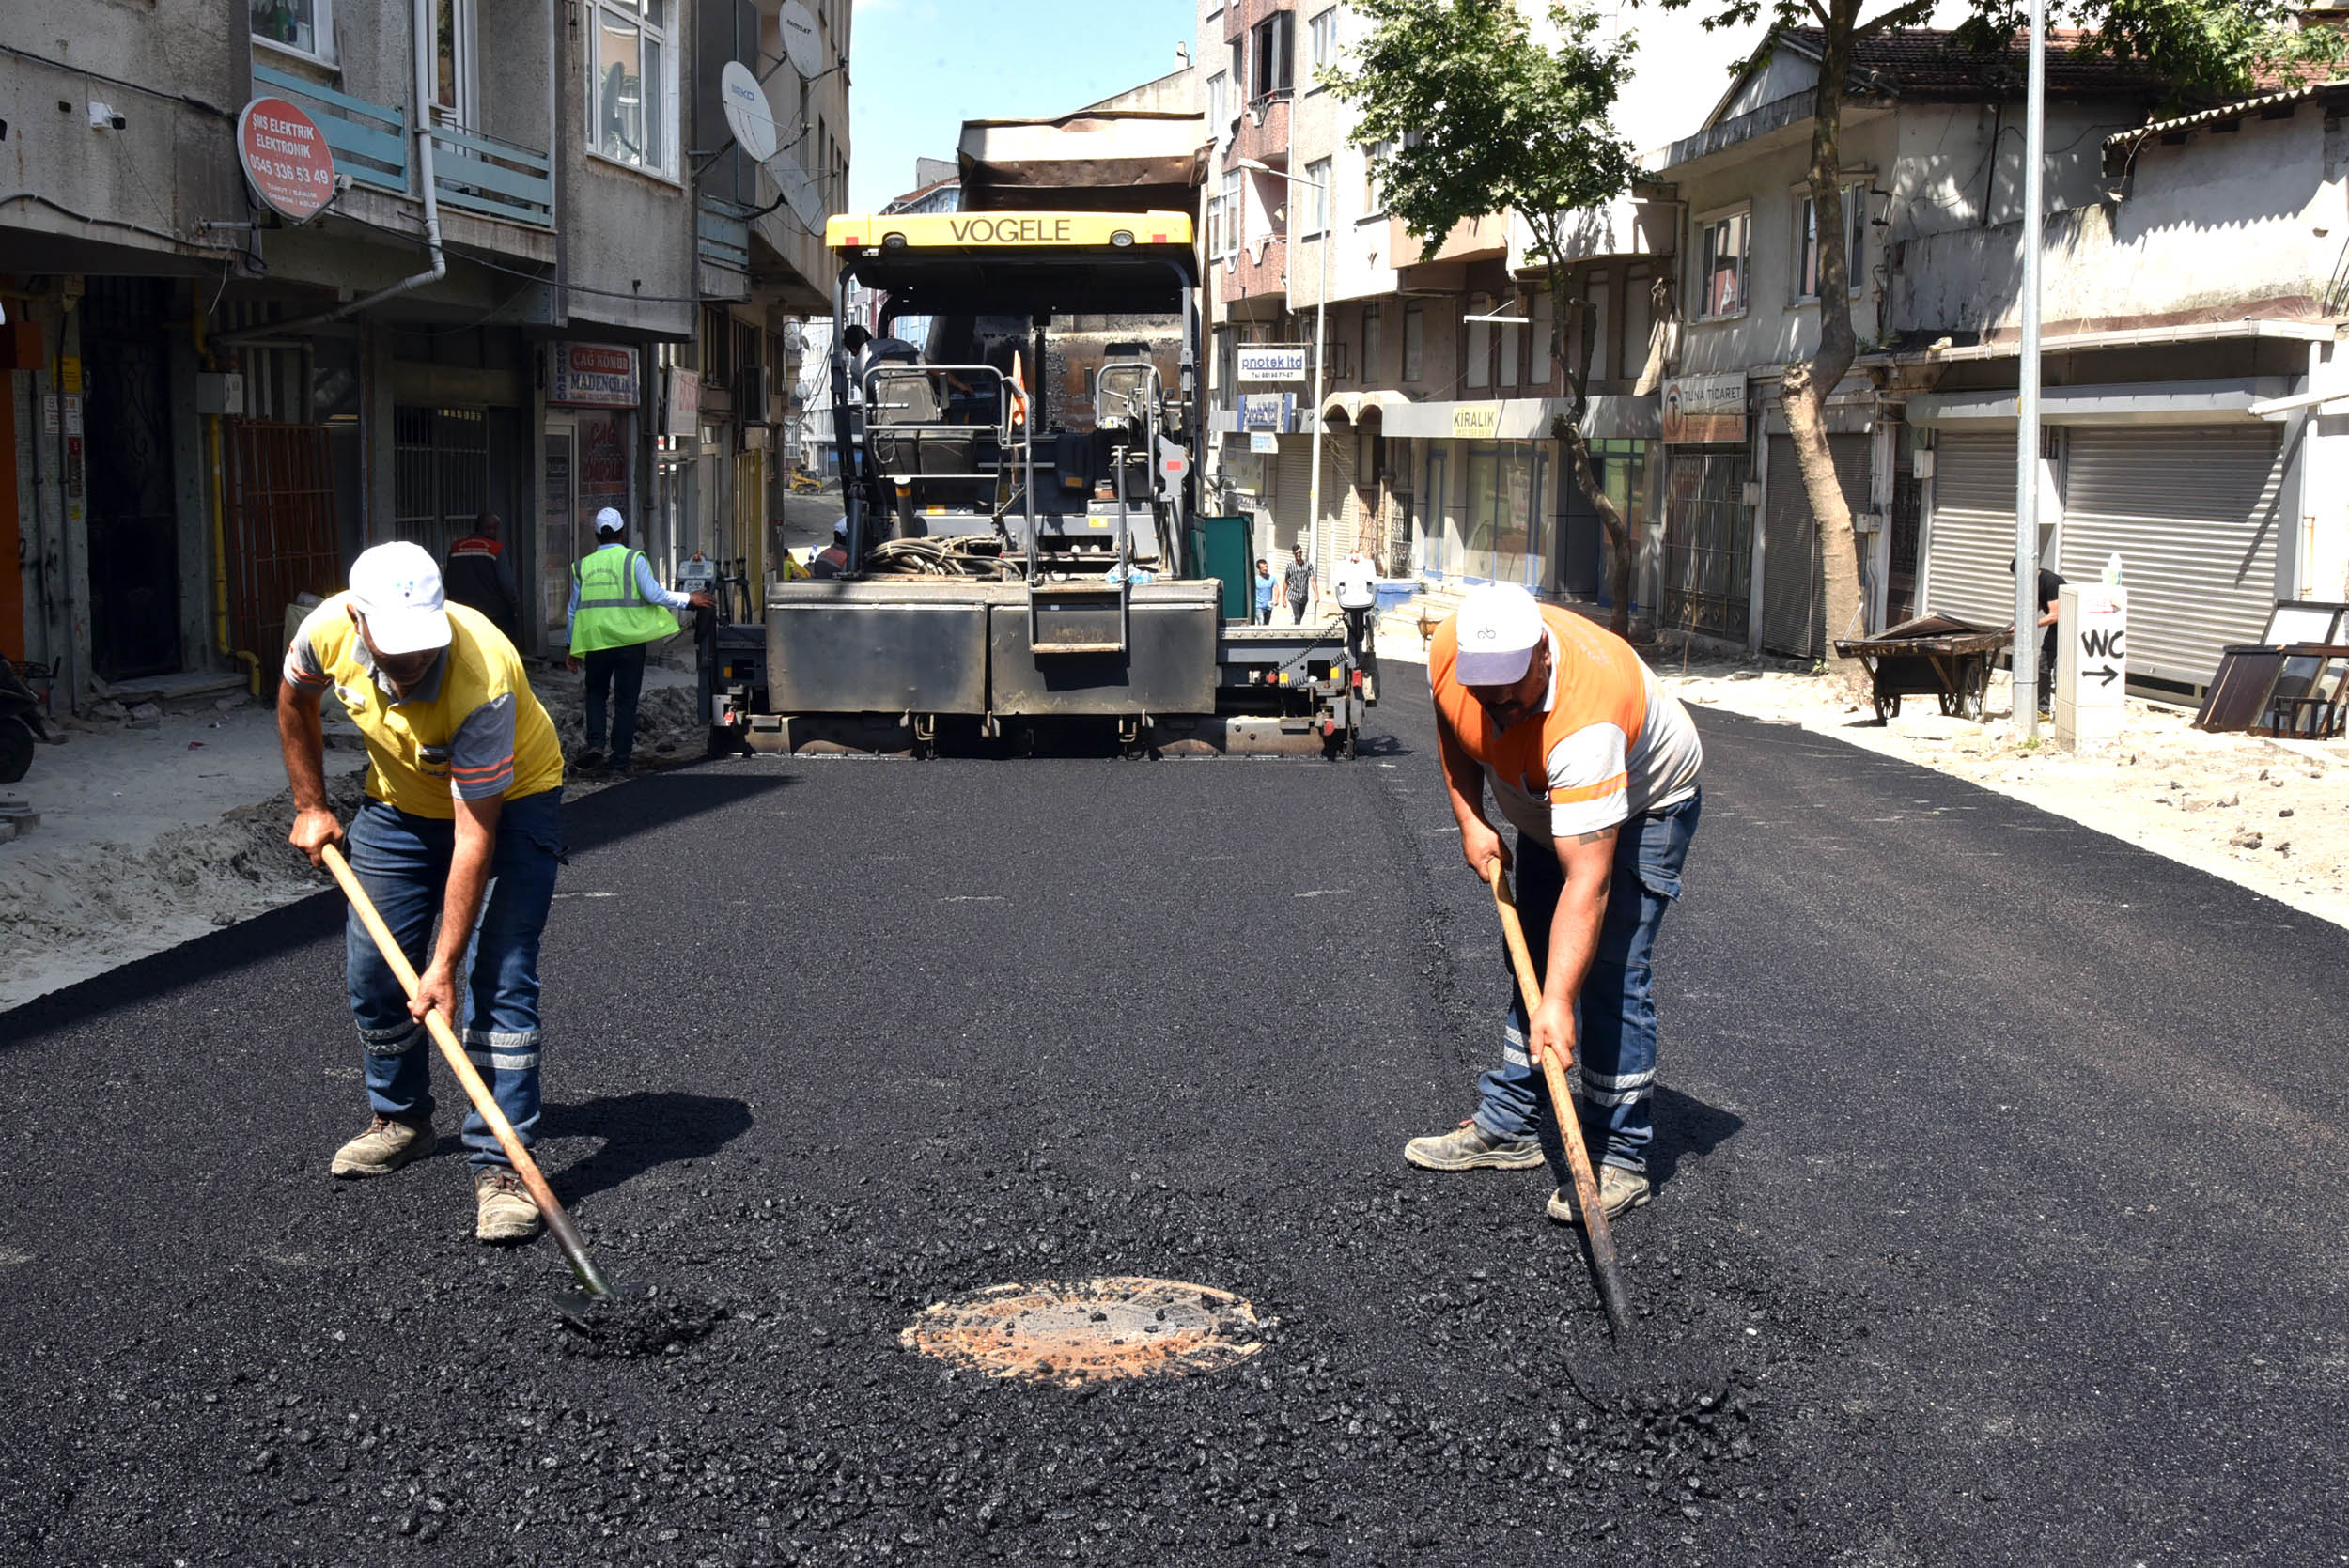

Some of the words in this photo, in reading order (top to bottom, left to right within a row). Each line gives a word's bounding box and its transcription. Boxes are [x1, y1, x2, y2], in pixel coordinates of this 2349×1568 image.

[250, 153, 272, 176] 0545
[273, 163, 294, 180] 336
[296, 167, 311, 182] 53
[314, 170, 329, 184] 49
[950, 215, 1071, 242] VÖGELE
[573, 349, 595, 369] ÇAĞ
[1287, 355, 1303, 369] ltd
[1684, 390, 1705, 403] TUNA
[1454, 408, 1495, 427] KİRALIK
[2081, 629, 2124, 659] WC
